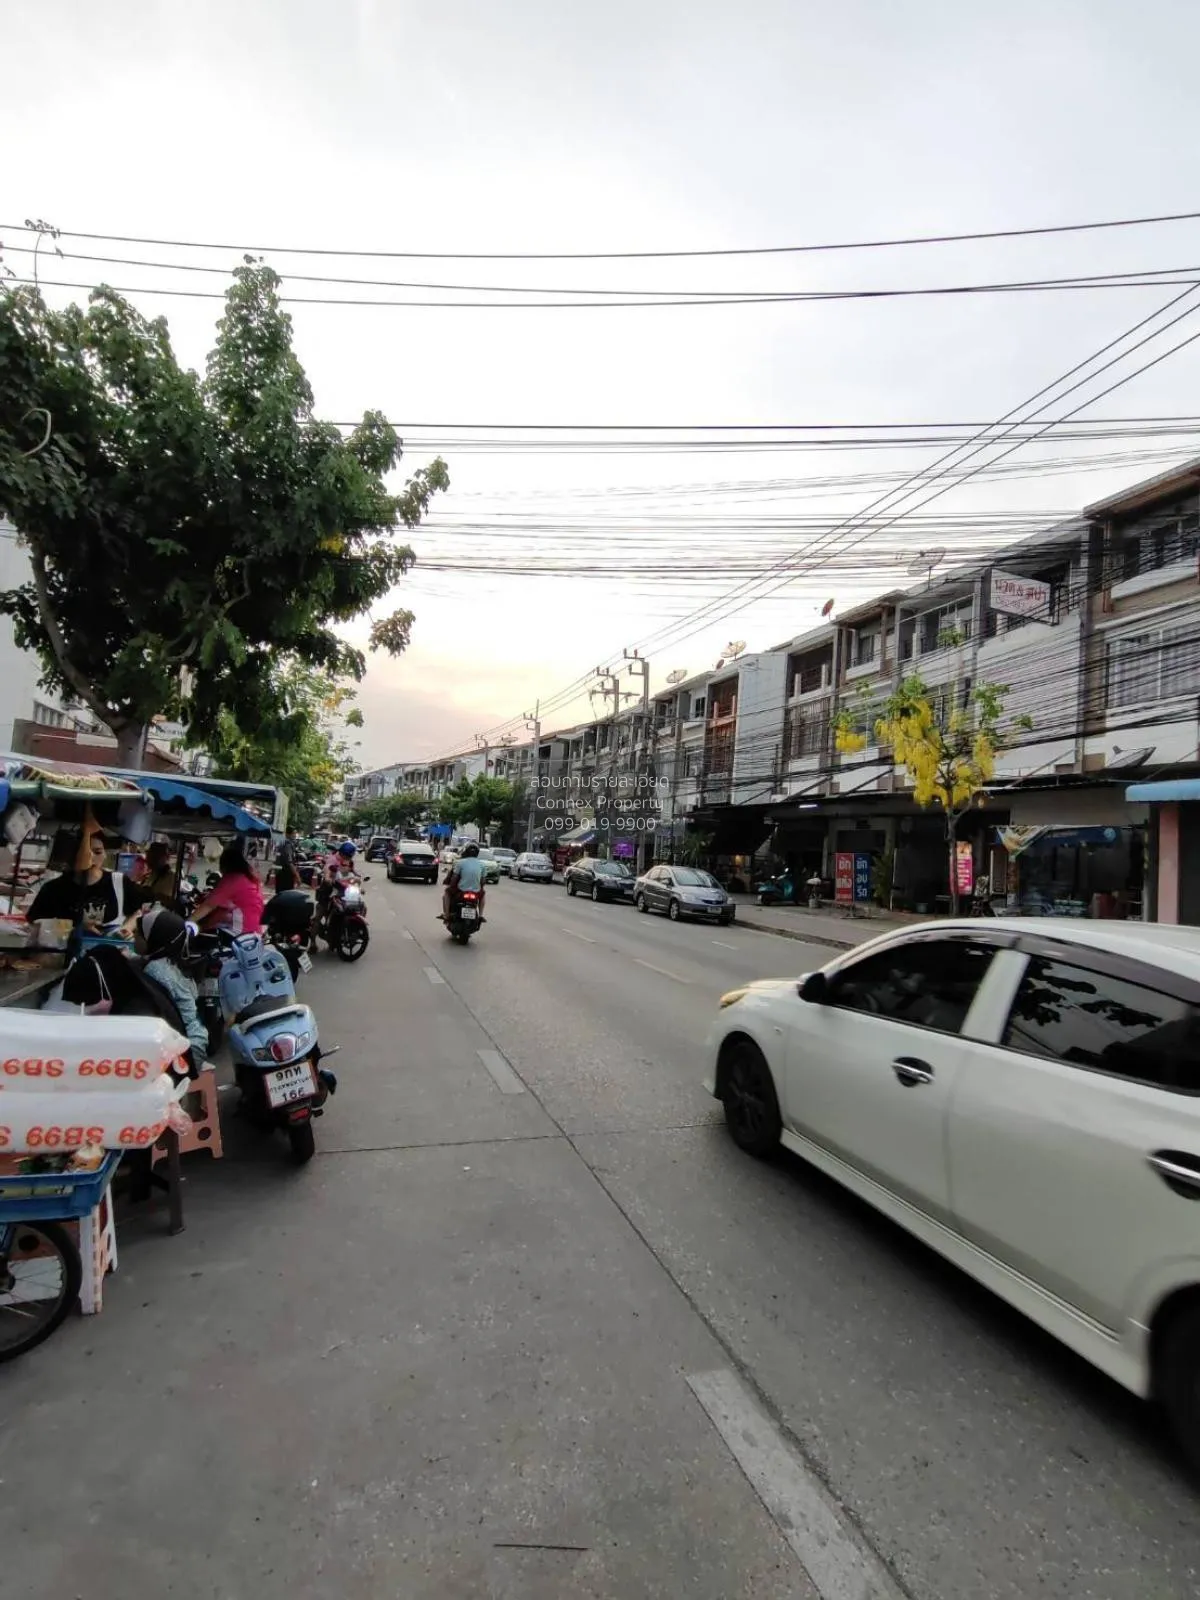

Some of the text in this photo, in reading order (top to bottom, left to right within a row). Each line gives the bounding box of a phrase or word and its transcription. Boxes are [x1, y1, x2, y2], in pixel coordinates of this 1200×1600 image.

[1, 1058, 150, 1079] SB99 SB9
[26, 1126, 105, 1147] SB99
